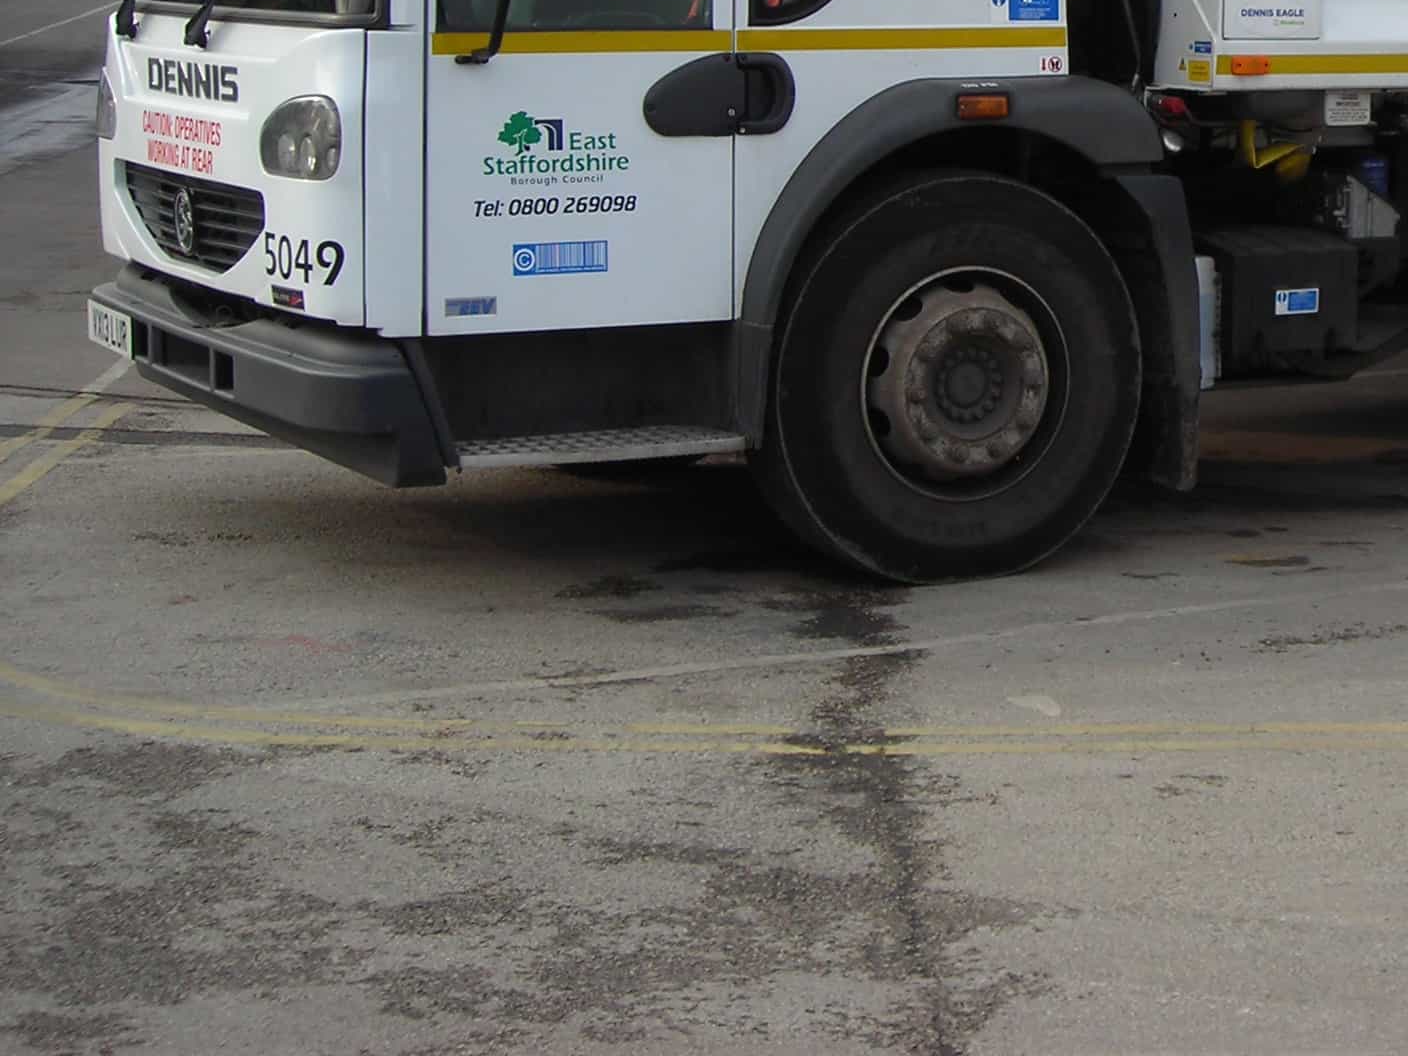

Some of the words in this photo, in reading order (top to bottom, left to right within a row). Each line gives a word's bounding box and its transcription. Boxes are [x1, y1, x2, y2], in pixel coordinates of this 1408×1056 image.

[1240, 8, 1274, 17] DENNIS
[1276, 8, 1305, 17] EAGLE
[148, 58, 239, 102] DENNIS
[175, 115, 222, 146] OPERATIVES
[569, 132, 617, 150] East
[147, 140, 180, 167] WORKING
[180, 147, 191, 169] AT
[192, 148, 213, 175] REAR
[483, 152, 630, 175] Staffordshire
[510, 175, 558, 187] Borough
[562, 174, 604, 185] Council
[473, 199, 504, 218] Tel:
[508, 197, 559, 216] 0800
[563, 195, 638, 214] 269098
[264, 231, 345, 286] 5049
